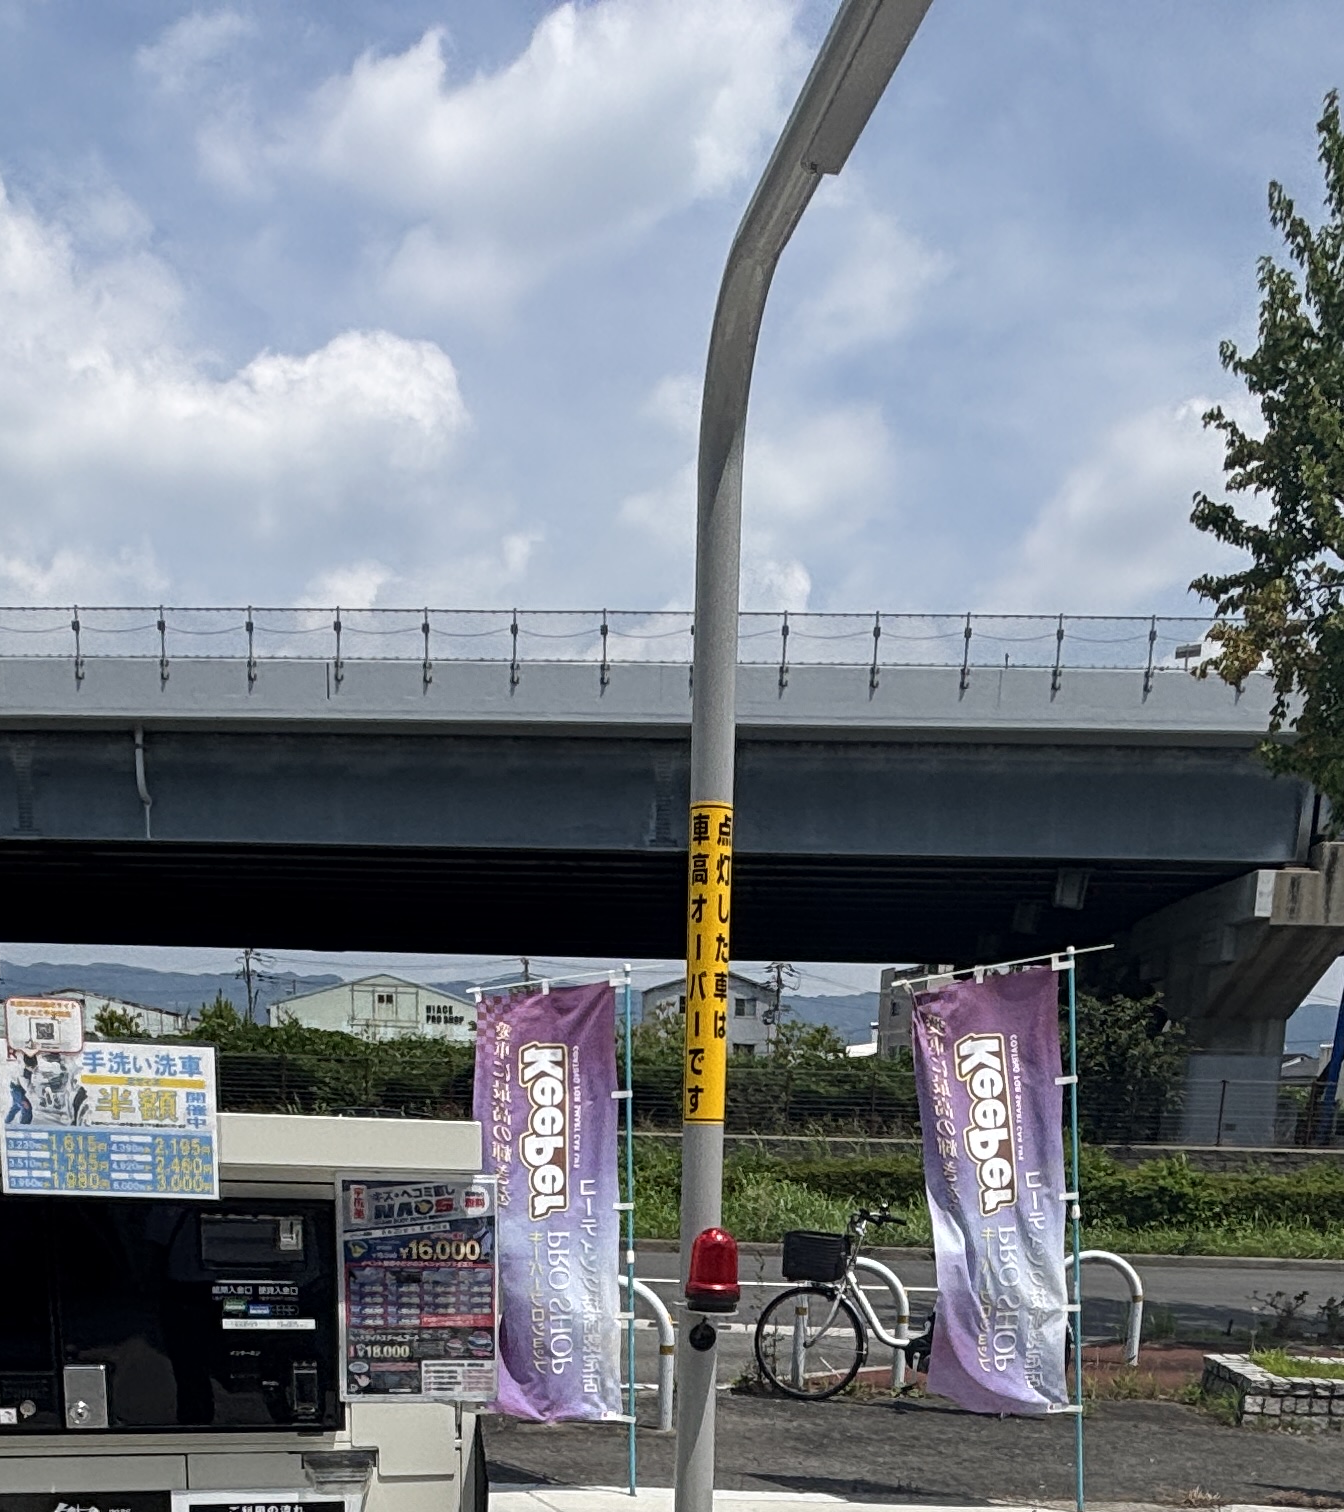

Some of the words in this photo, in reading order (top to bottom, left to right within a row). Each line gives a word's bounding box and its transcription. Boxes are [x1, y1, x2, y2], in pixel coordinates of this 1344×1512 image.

[714, 814, 732, 1039] 点灯した車は
[687, 812, 711, 1114] 車高オーバーです
[81, 1050, 204, 1078] 手洗い洗車
[94, 1086, 179, 1123] 半額
[185, 1091, 207, 1130] 開催中
[399, 1239, 480, 1262] ¥16,000
